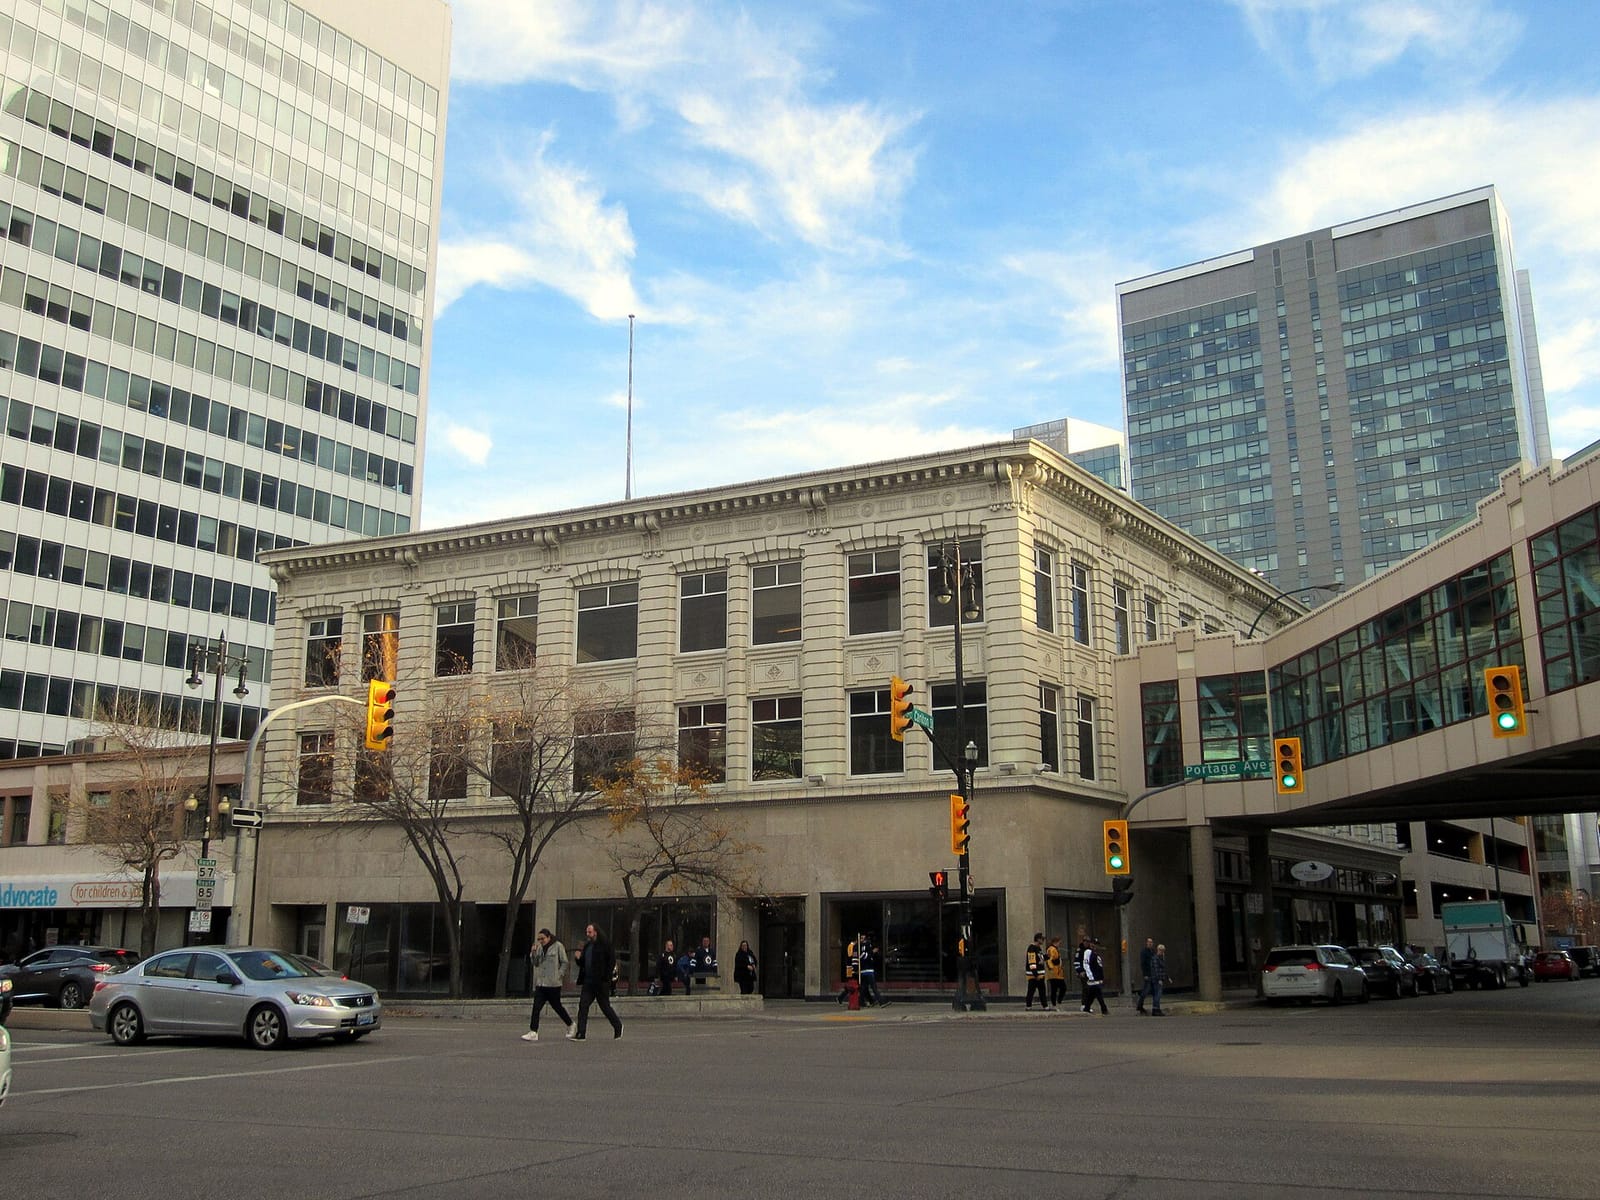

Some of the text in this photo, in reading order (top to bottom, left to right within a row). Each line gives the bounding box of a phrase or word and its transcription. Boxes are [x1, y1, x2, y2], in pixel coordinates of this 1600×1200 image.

[1186, 761, 1267, 775] Portage Ave
[200, 867, 214, 877] 57
[0, 883, 57, 907] dvocate
[76, 886, 88, 898] for
[89, 886, 120, 898] children
[122, 885, 128, 898] &
[198, 887, 213, 898] 85
